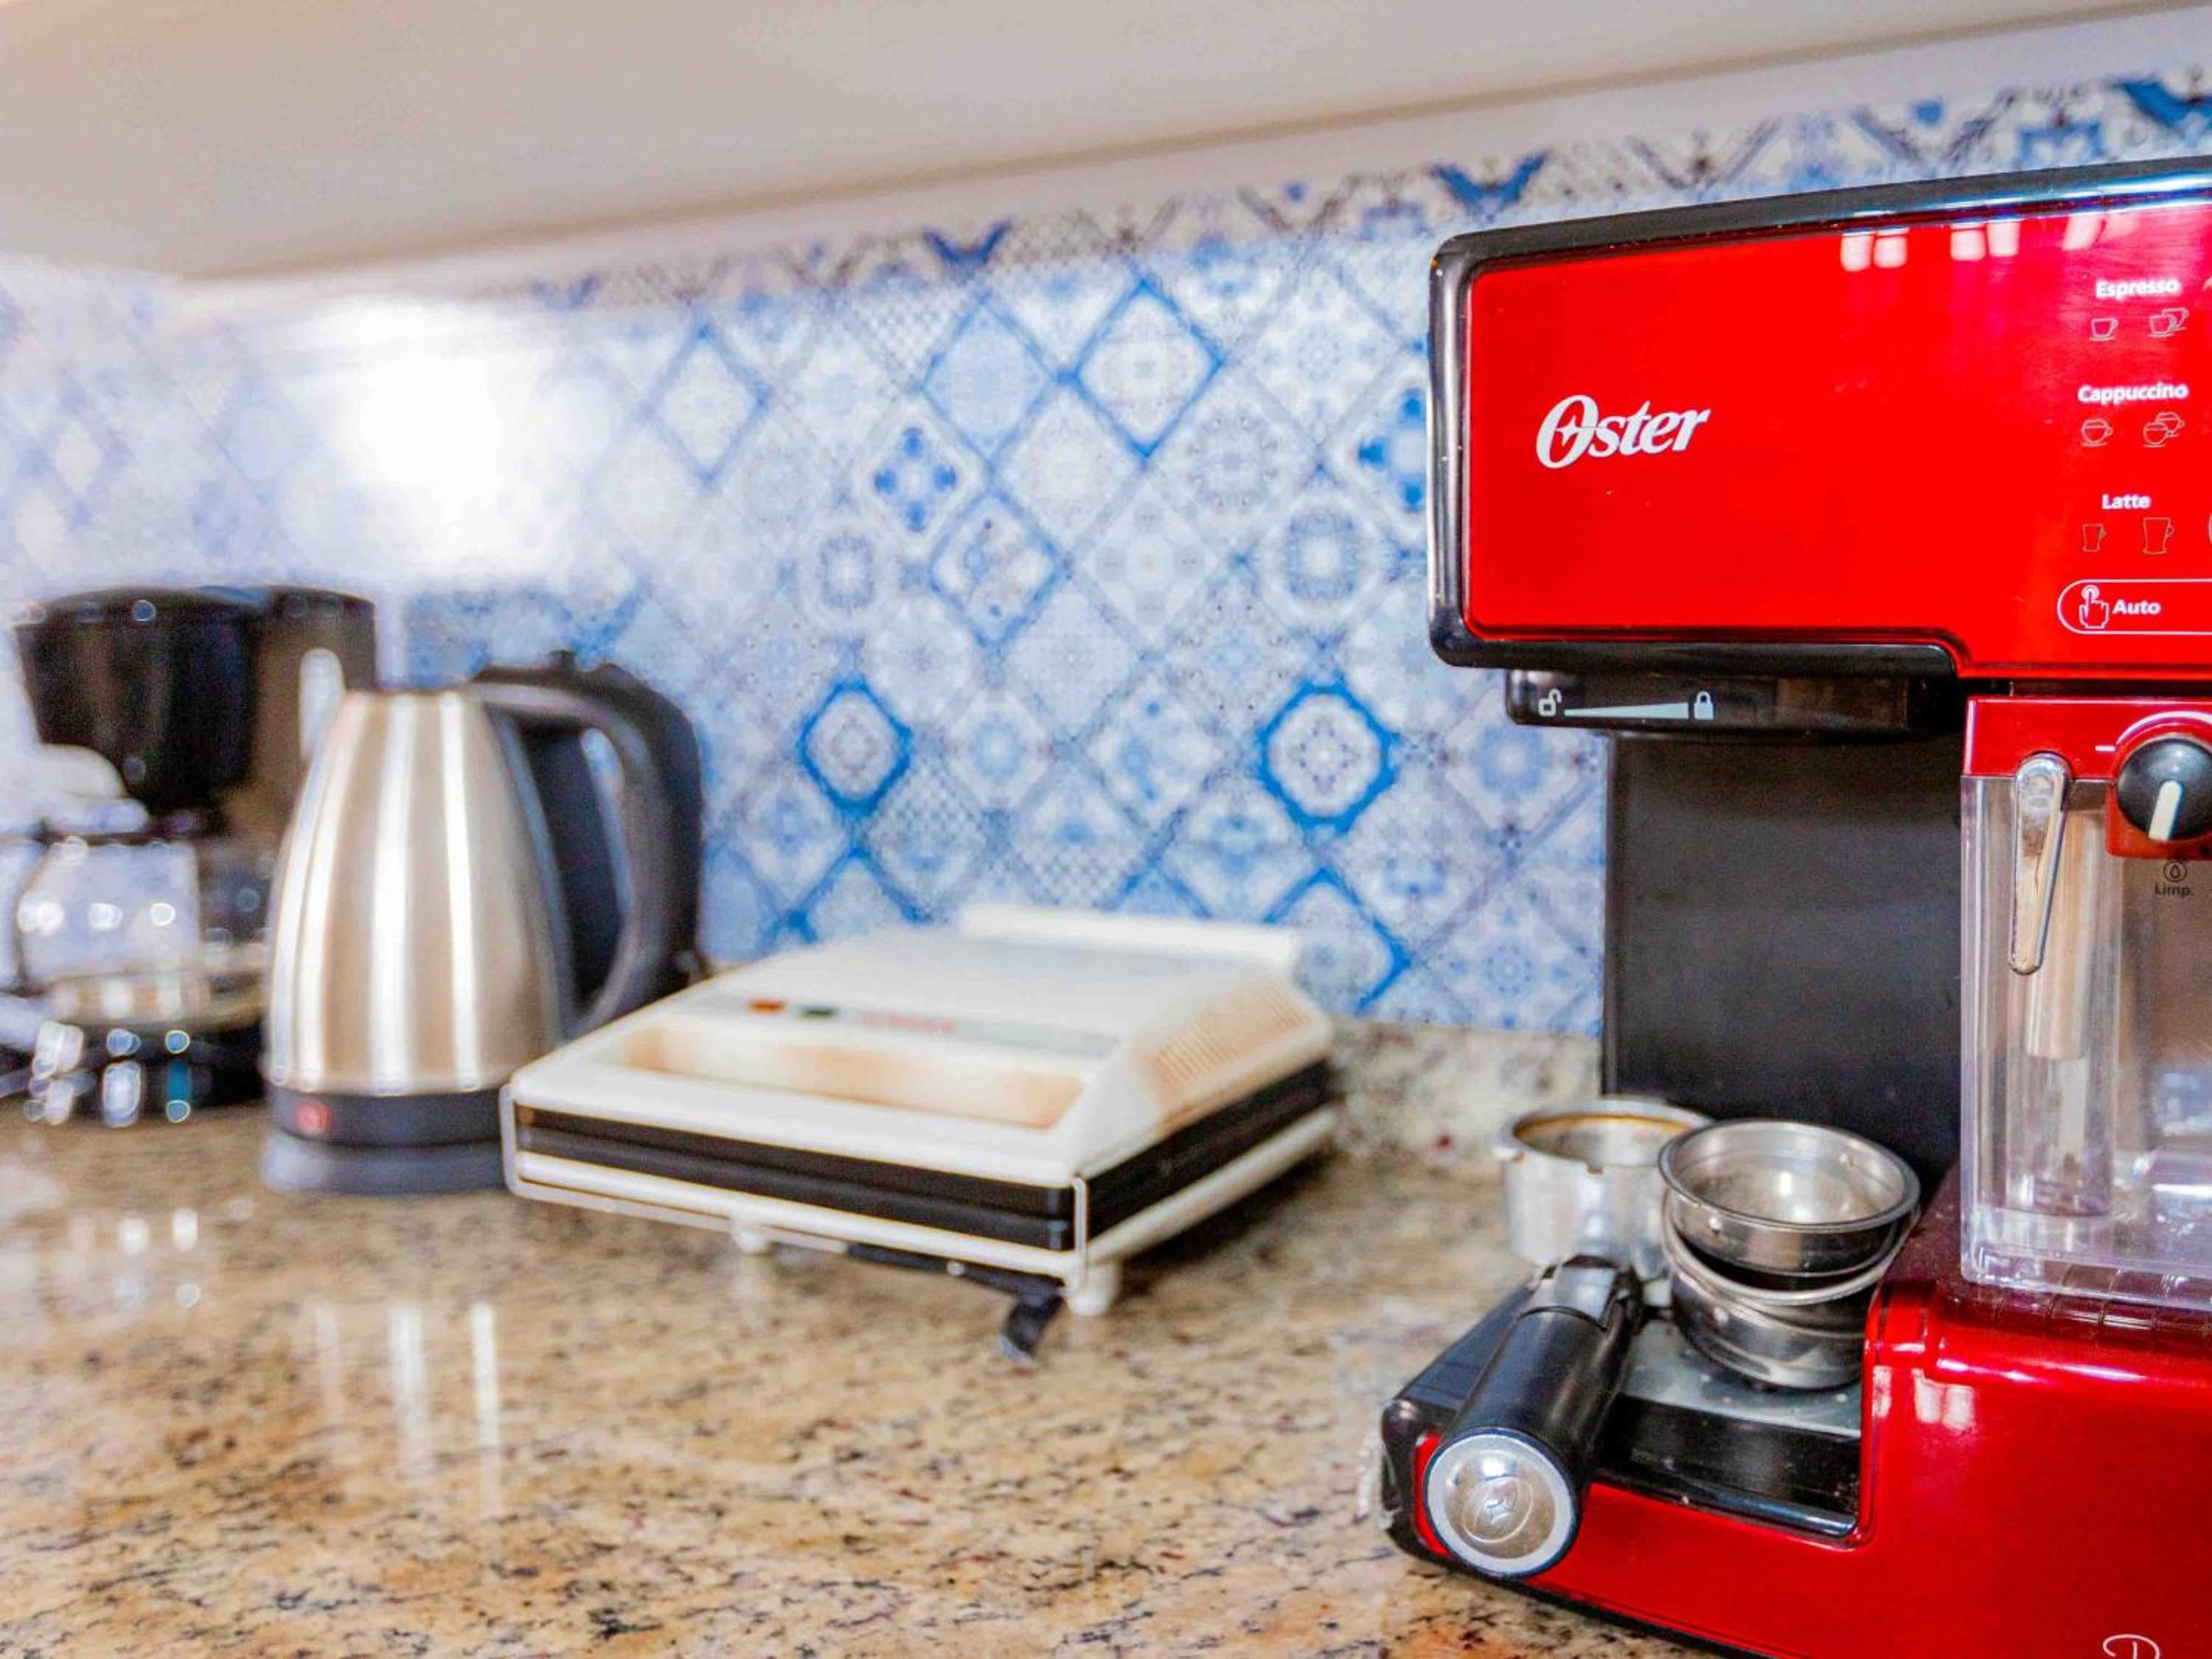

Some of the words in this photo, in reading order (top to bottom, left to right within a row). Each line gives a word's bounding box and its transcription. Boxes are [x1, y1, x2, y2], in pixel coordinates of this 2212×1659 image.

[2096, 278, 2181, 299] Espresso
[2078, 381, 2188, 405] Cappuccino
[1536, 394, 1711, 468] Oster
[2102, 493, 2151, 509] Latte
[2112, 599, 2160, 615] Auto
